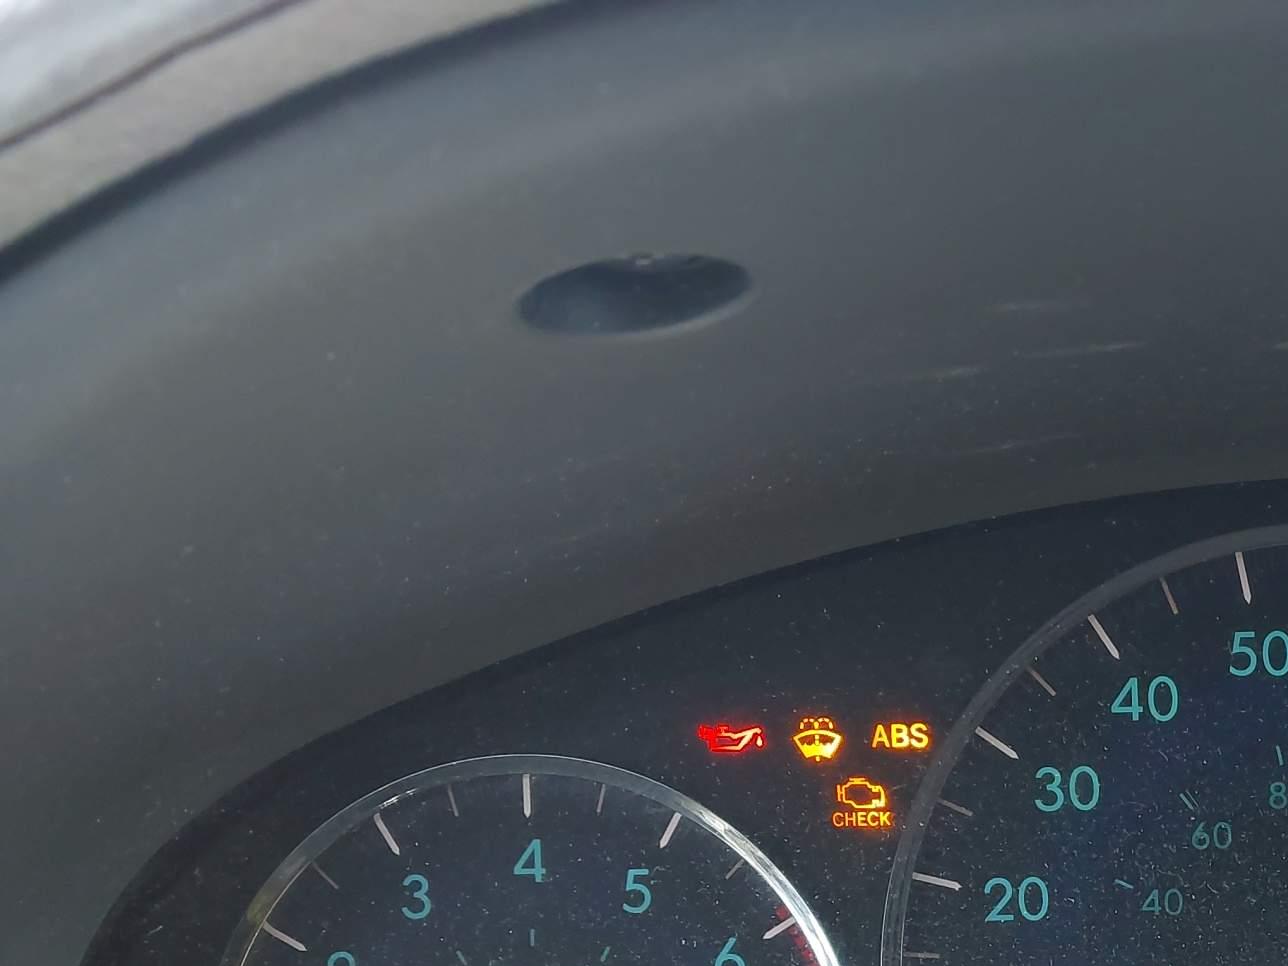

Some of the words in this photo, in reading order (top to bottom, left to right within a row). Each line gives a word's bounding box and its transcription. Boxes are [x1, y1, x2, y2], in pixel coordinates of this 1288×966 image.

[1111, 676, 1179, 721] 40
[872, 723, 928, 748] ABS
[1034, 766, 1100, 812] 30
[833, 812, 891, 827] CHECK
[1192, 822, 1232, 850] 60
[513, 839, 546, 882] 4
[402, 875, 431, 919] 3
[623, 869, 652, 913] 5
[984, 877, 1049, 921] 20
[1142, 889, 1184, 916] 40
